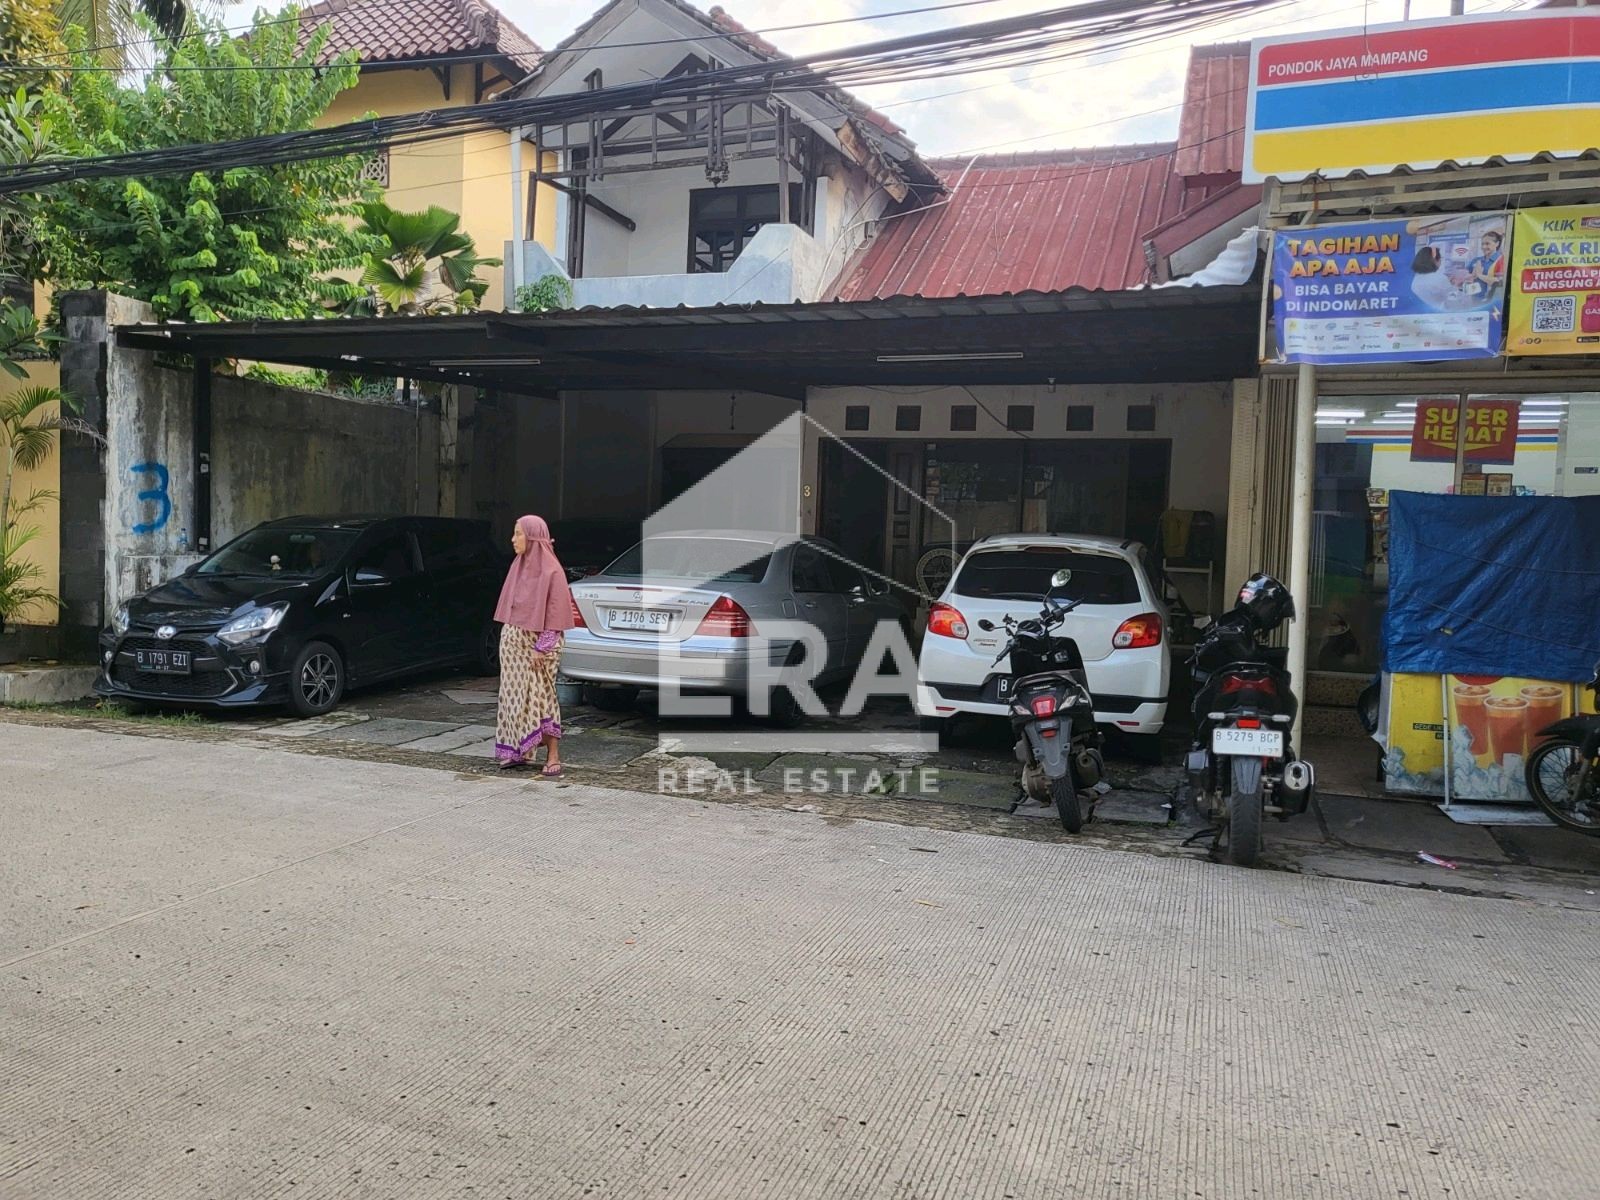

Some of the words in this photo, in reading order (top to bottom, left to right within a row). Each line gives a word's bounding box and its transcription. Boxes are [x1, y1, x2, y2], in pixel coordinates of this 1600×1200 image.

[1268, 59, 1323, 77] PONDOK
[1326, 56, 1357, 71] JAYA
[1360, 49, 1428, 67] MAMPANG
[1287, 233, 1400, 257] TAGIHAN
[1530, 241, 1574, 257] GAK
[1290, 259, 1340, 278] APA
[1343, 256, 1395, 275] AJA
[1524, 256, 1569, 267] ANGKAT
[1533, 269, 1589, 280] TINGGAL
[1295, 284, 1330, 296] BISA
[1334, 281, 1389, 295] BAYAR
[1523, 278, 1594, 290] LANGSUNG
[1286, 301, 1300, 312] DI
[1304, 296, 1399, 312] INDOMARET
[1425, 407, 1509, 426] SUPER
[1423, 425, 1507, 442] HEMAT
[130, 462, 171, 535] 3
[804, 485, 811, 497] 3
[610, 610, 617, 622] B
[622, 610, 645, 623] 1196
[650, 612, 668, 625] SES
[137, 651, 144, 663] B
[149, 652, 167, 665] 1791
[1000, 679, 1008, 692] B
[1215, 730, 1222, 741] B
[1227, 731, 1254, 742] 5279
[1260, 732, 1280, 743] BGP
